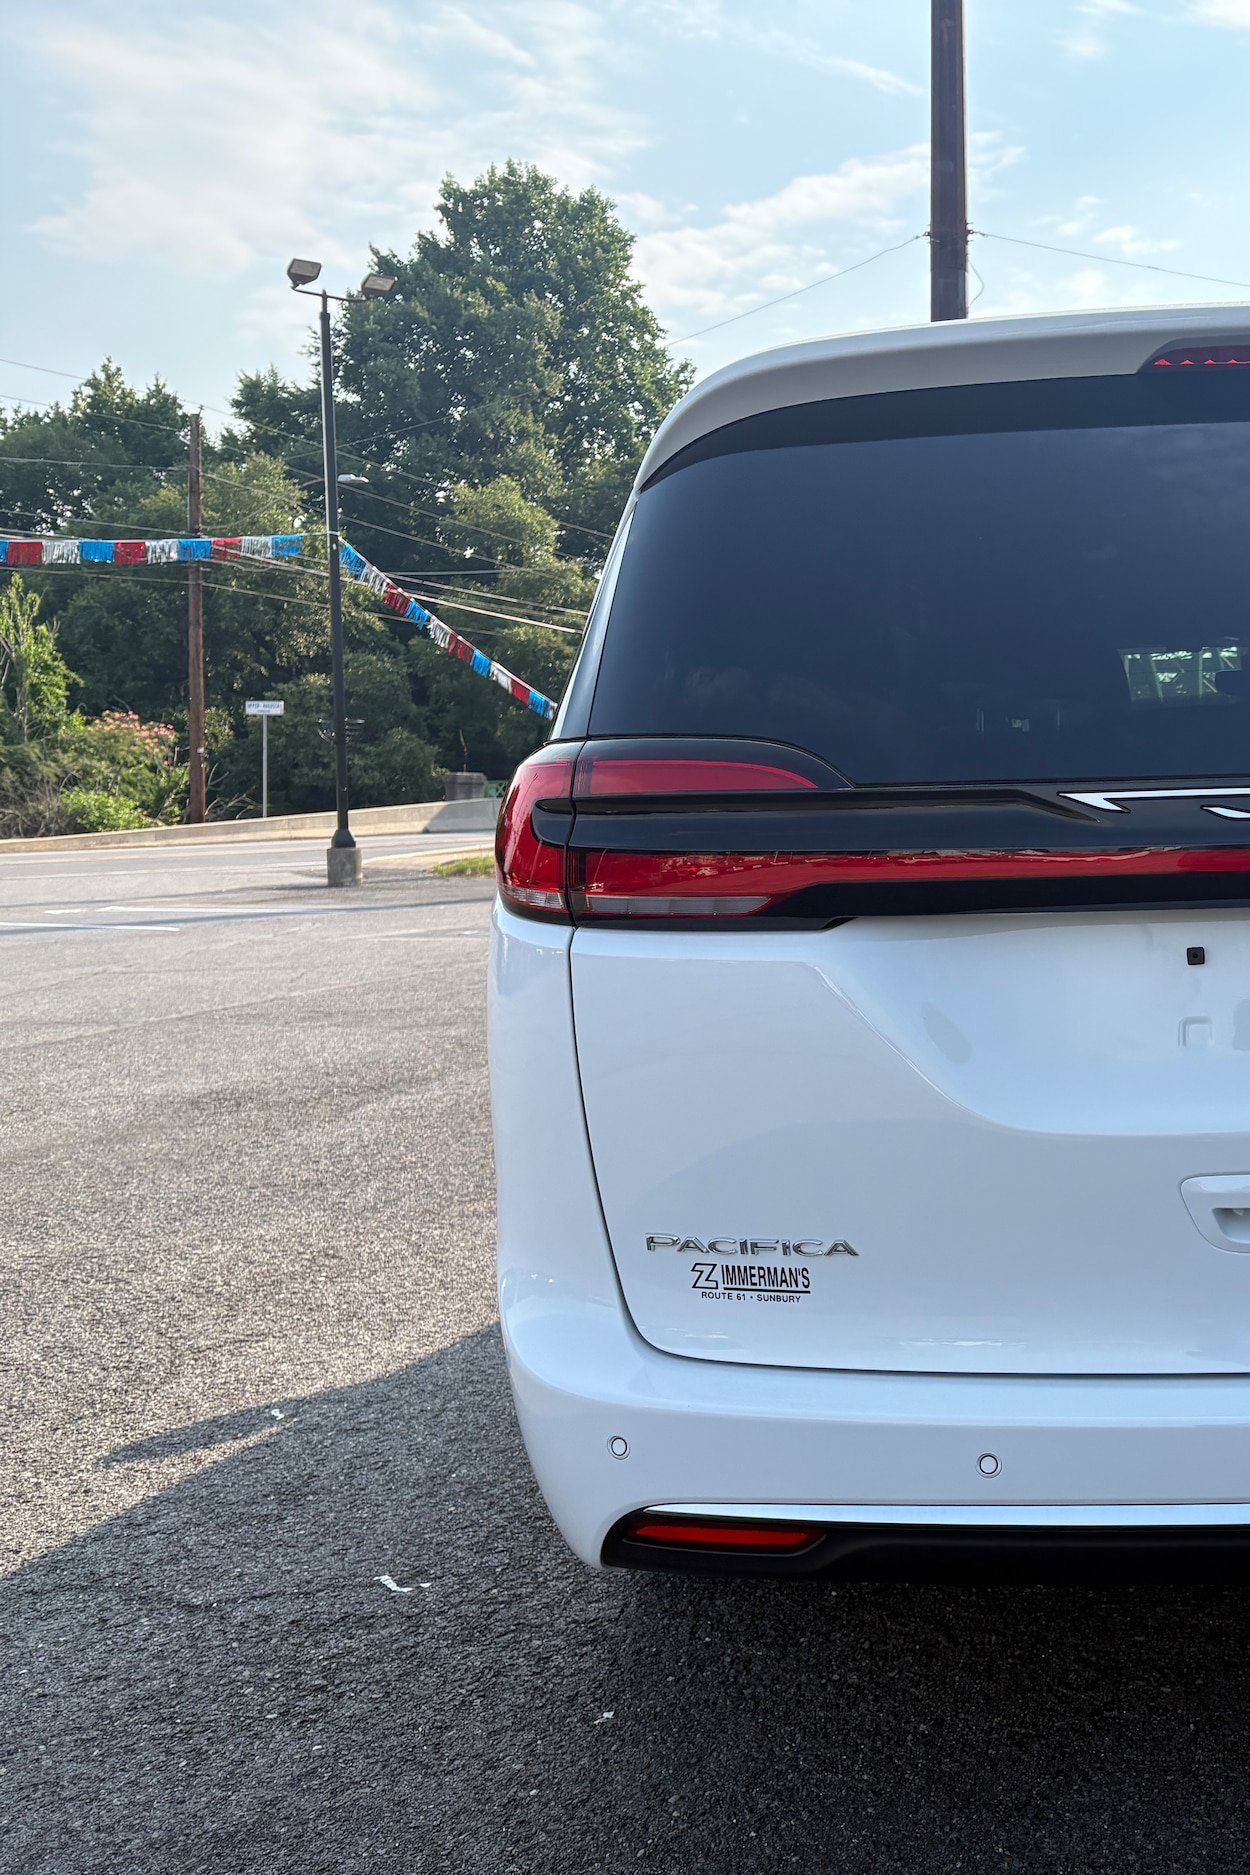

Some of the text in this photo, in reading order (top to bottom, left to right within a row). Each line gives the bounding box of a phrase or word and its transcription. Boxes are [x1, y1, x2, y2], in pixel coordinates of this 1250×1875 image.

[645, 1232, 860, 1257] PACIFICA
[690, 1262, 811, 1289] ZIMMERMAN'S
[701, 1291, 801, 1304] ROUTE 61 SUNBURY
